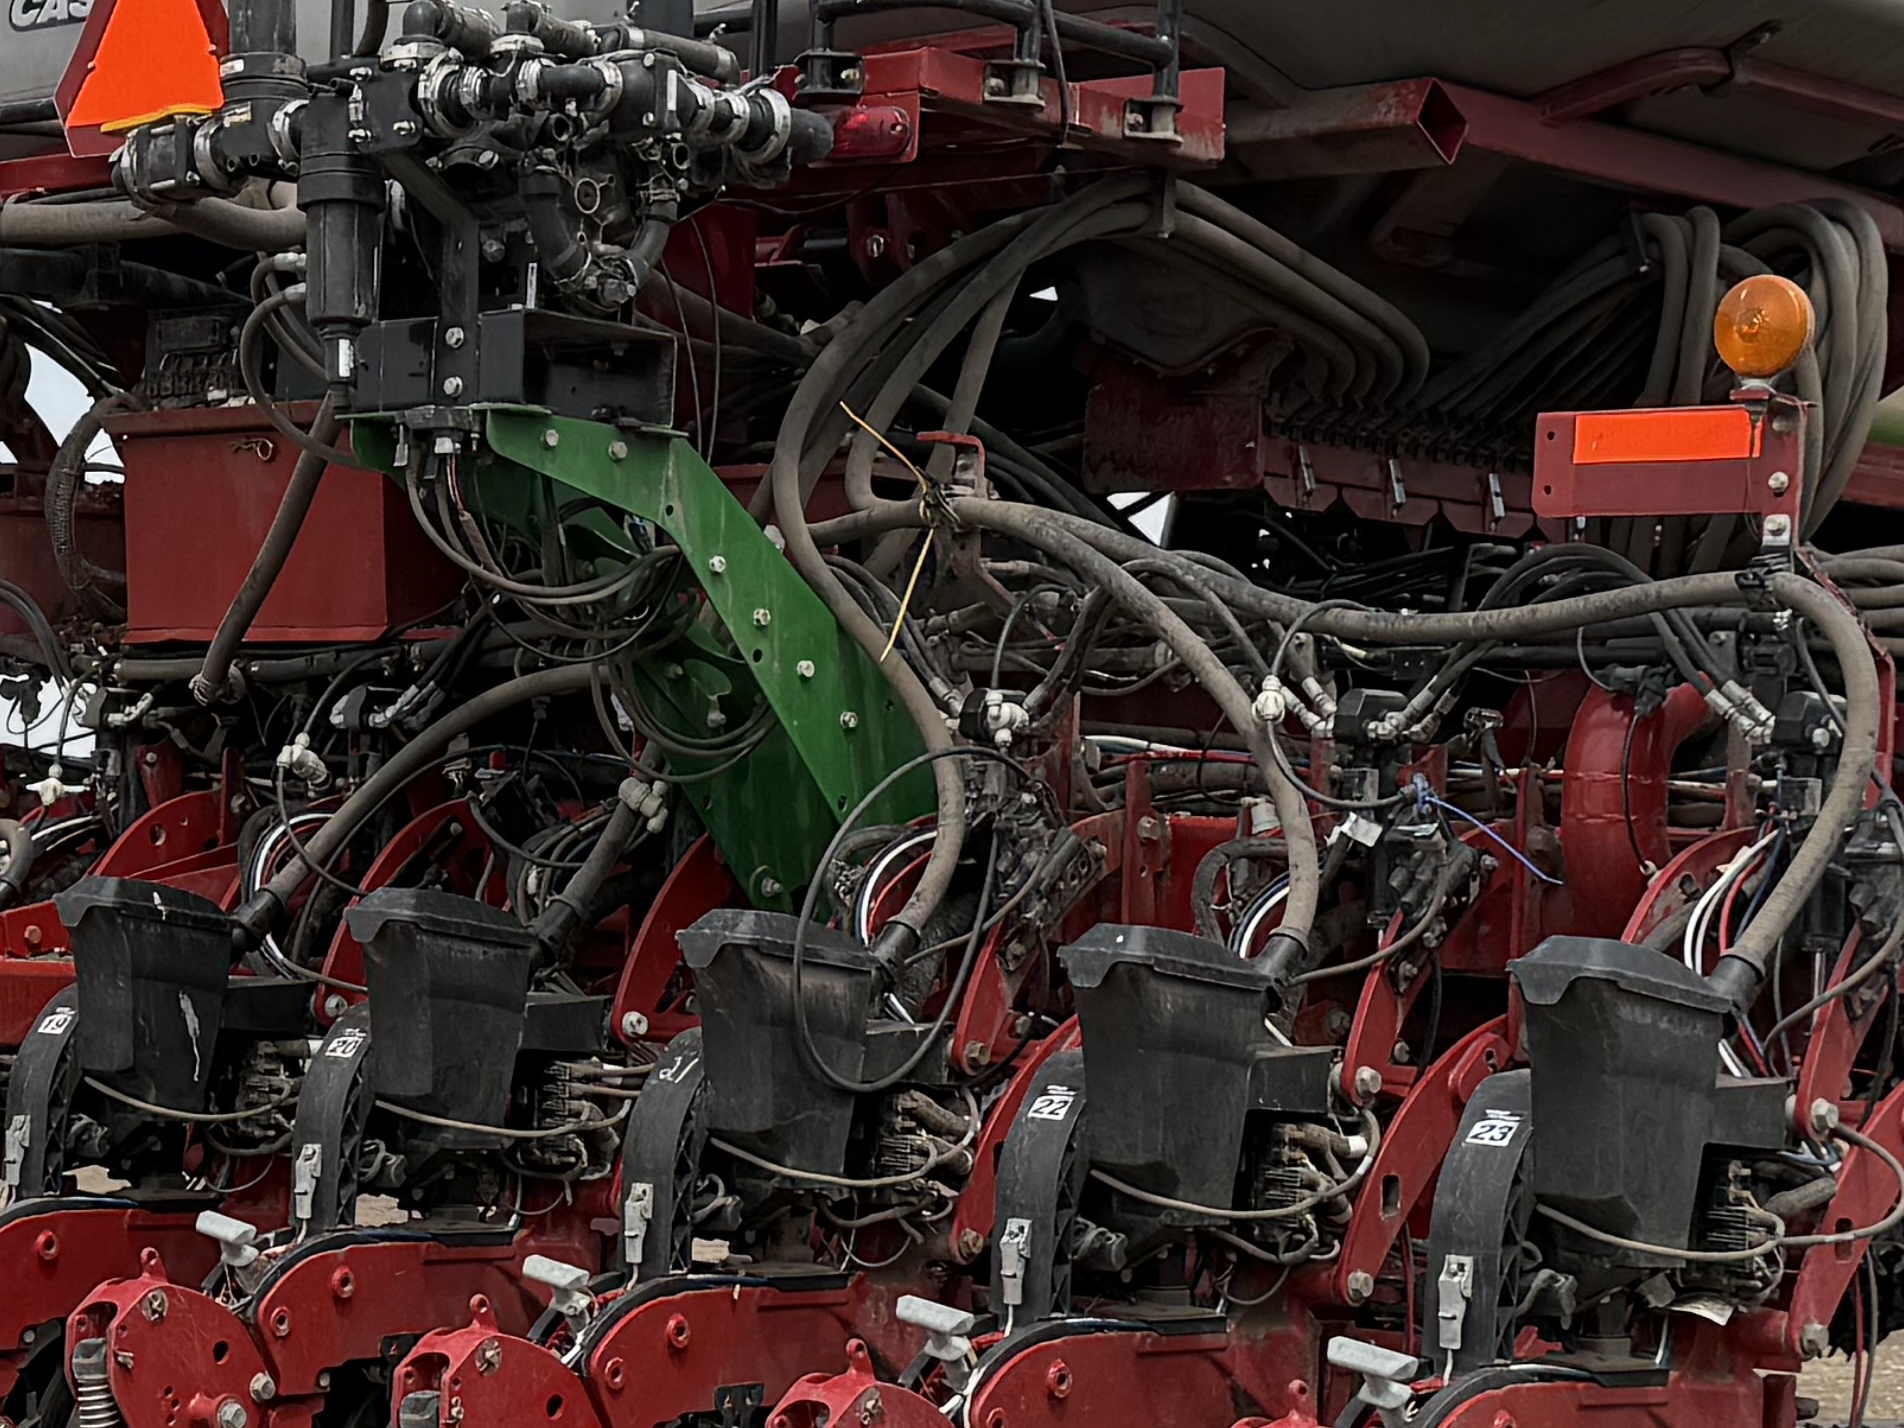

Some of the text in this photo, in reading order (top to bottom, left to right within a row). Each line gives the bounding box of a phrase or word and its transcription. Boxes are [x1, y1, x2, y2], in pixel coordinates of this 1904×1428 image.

[42, 1016, 69, 1031] 19
[328, 1039, 360, 1055] 20
[1031, 1098, 1070, 1116] 22
[1468, 1124, 1515, 1142] 23
